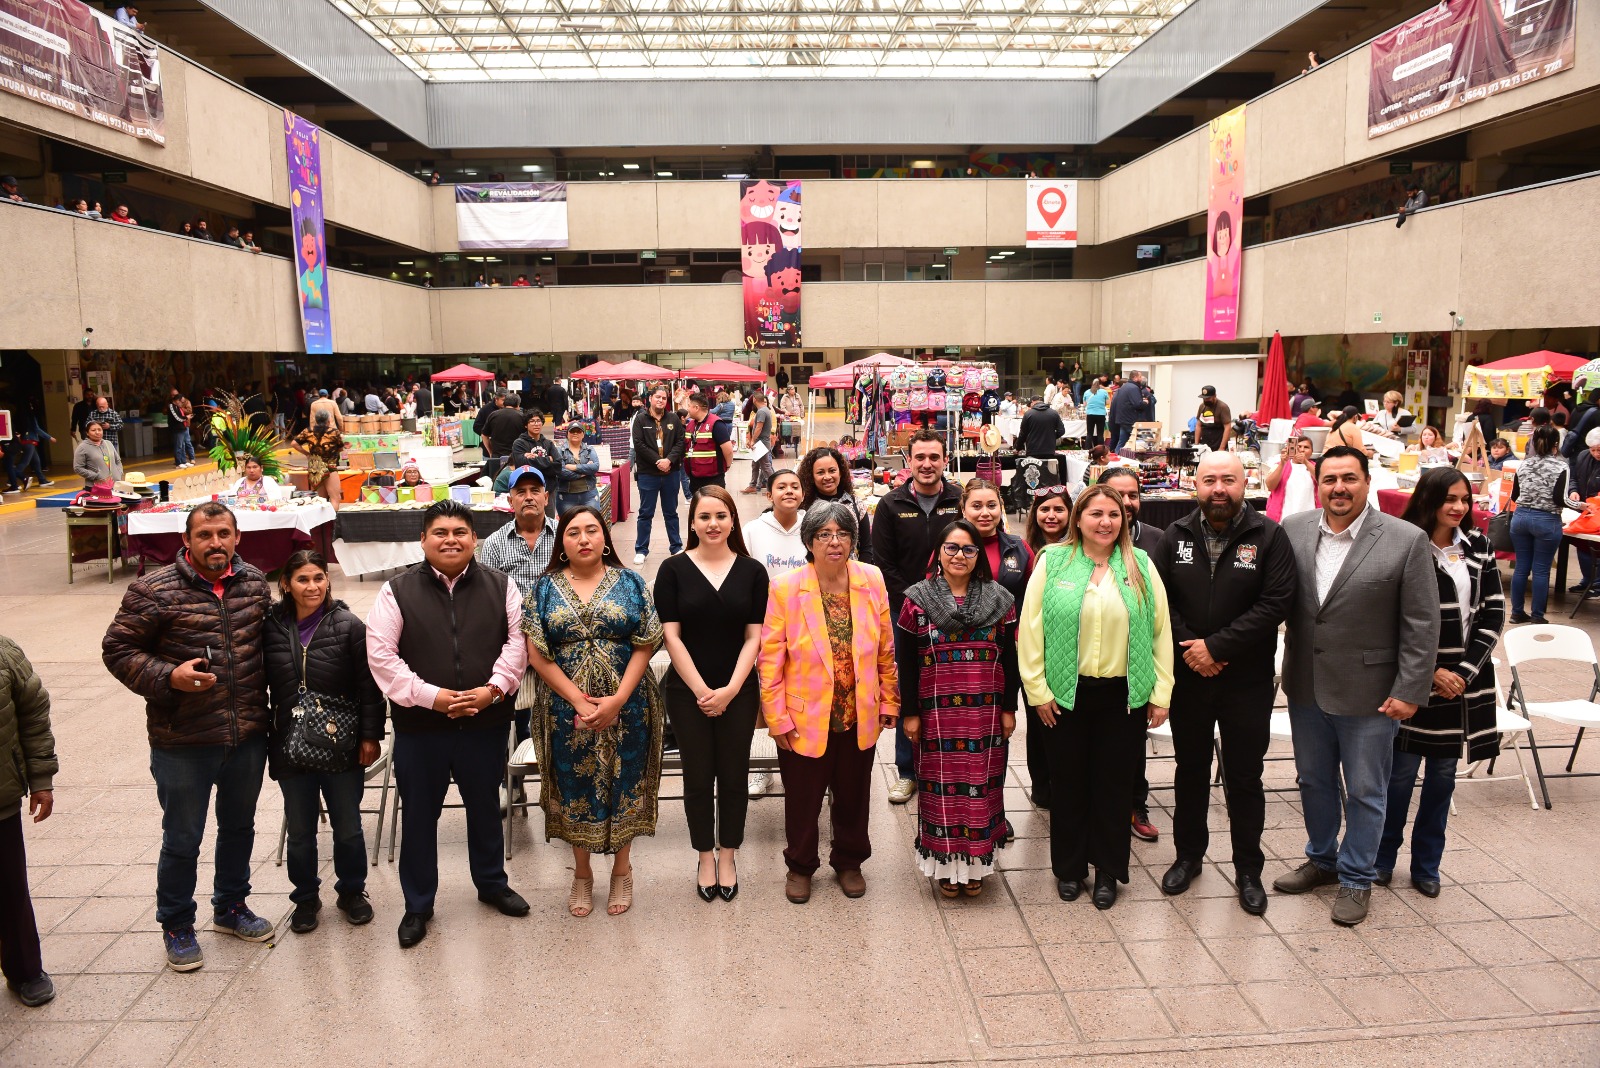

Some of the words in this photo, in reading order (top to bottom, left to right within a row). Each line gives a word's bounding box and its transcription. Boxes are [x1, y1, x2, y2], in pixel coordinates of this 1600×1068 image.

[22, 64, 53, 82] IMPRIME
[27, 86, 40, 99] VA
[1409, 112, 1419, 122] VA
[1464, 86, 1487, 103] (664)
[1500, 78, 1511, 90] 72
[1511, 74, 1521, 86] 73
[1521, 67, 1540, 82] EXT.
[1381, 101, 1402, 115] CAPTURA
[1408, 89, 1432, 104] IMPRIME
[489, 188, 540, 197] REVALIDACIÓN
